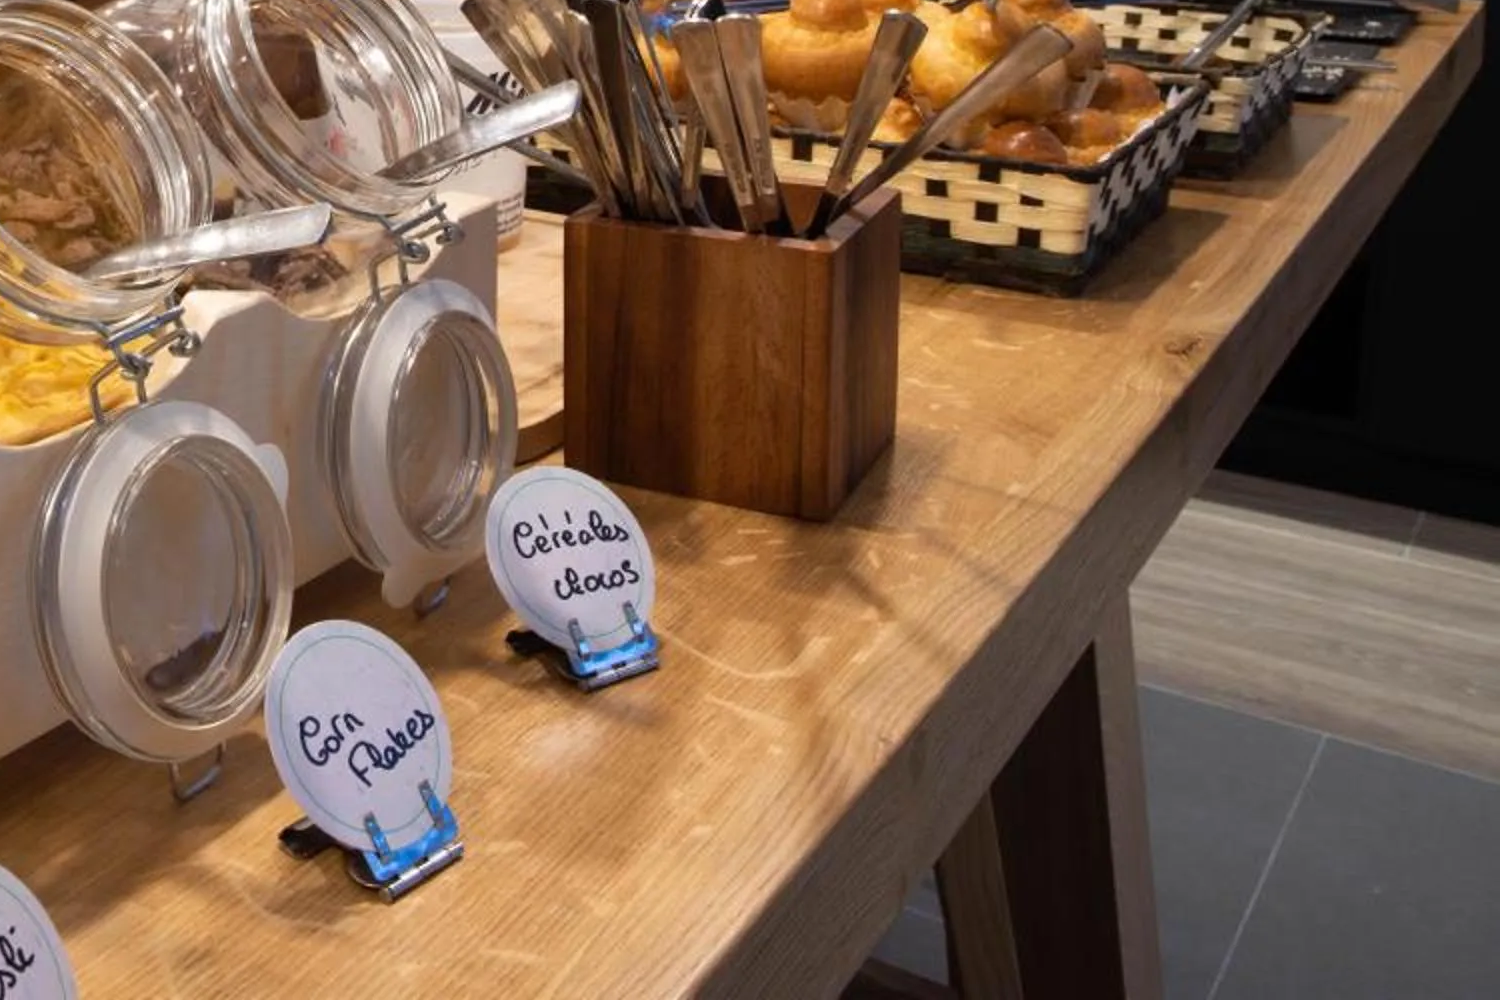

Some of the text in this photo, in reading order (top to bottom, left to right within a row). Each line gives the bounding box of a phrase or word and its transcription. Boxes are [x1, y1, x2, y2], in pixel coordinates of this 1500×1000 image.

[512, 509, 629, 559] Céréales
[298, 712, 364, 767] Corn
[347, 709, 435, 788] Flakes
